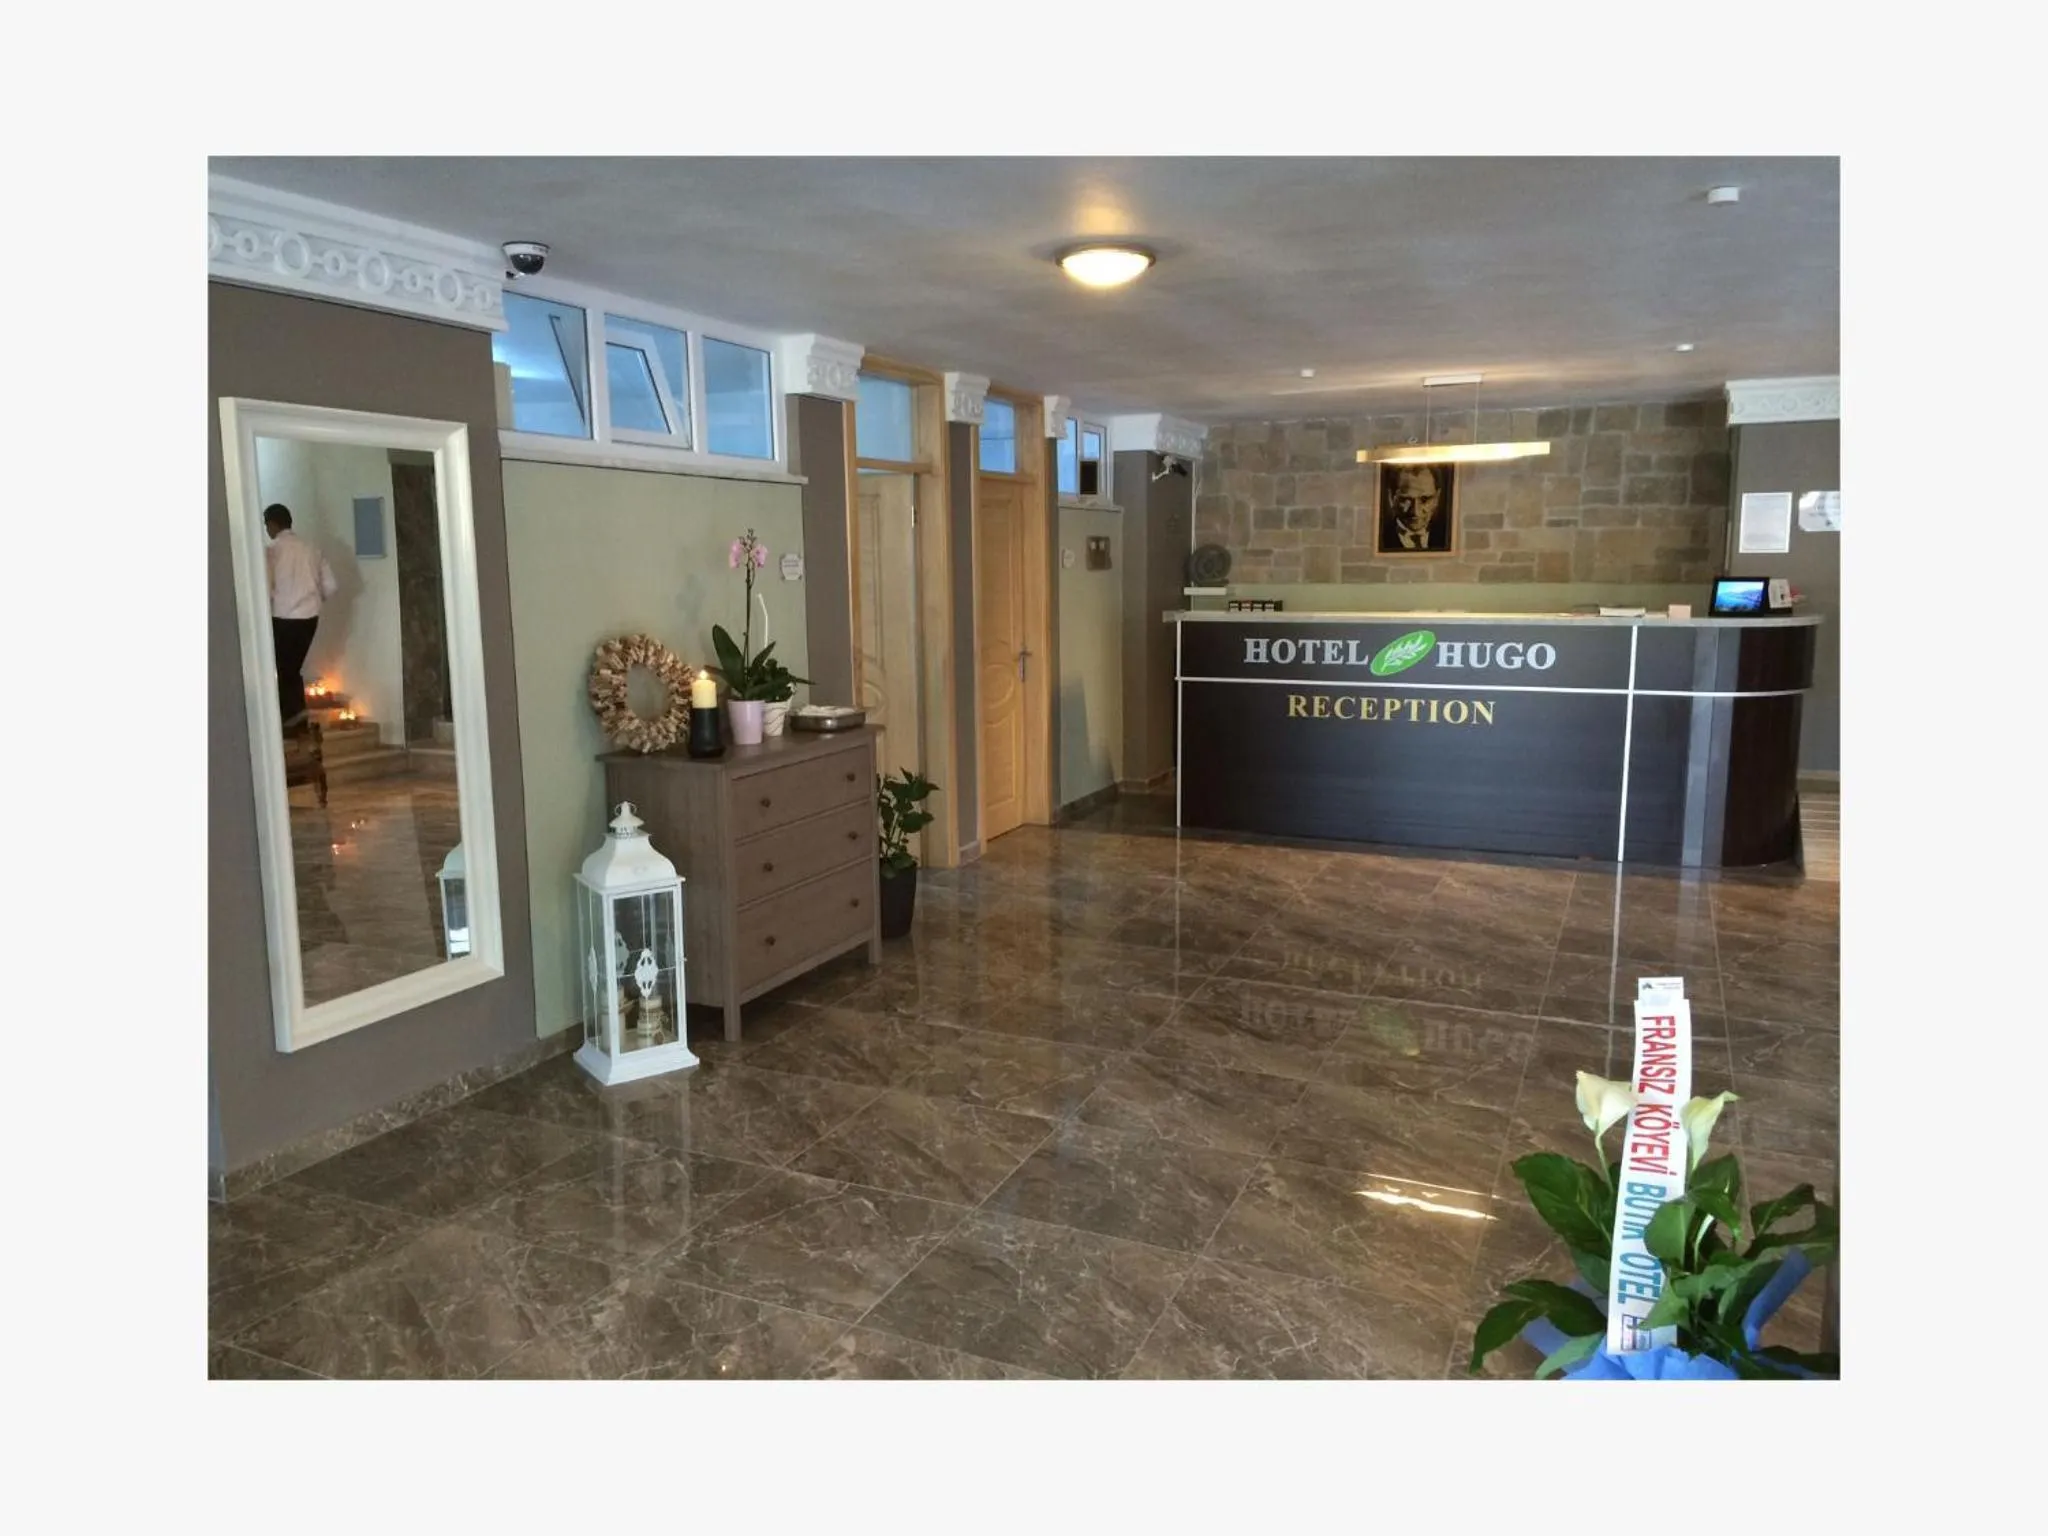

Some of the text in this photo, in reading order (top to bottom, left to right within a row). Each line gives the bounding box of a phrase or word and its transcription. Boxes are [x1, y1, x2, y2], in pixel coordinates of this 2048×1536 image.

[1243, 638, 1557, 670] HOTEL HUGO
[1287, 694, 1496, 724] RECEPTION
[1637, 1015, 1677, 1096] FRANSIZ
[1628, 1103, 1678, 1176] KÖYEVİ
[1617, 1252, 1662, 1304] OTEL
